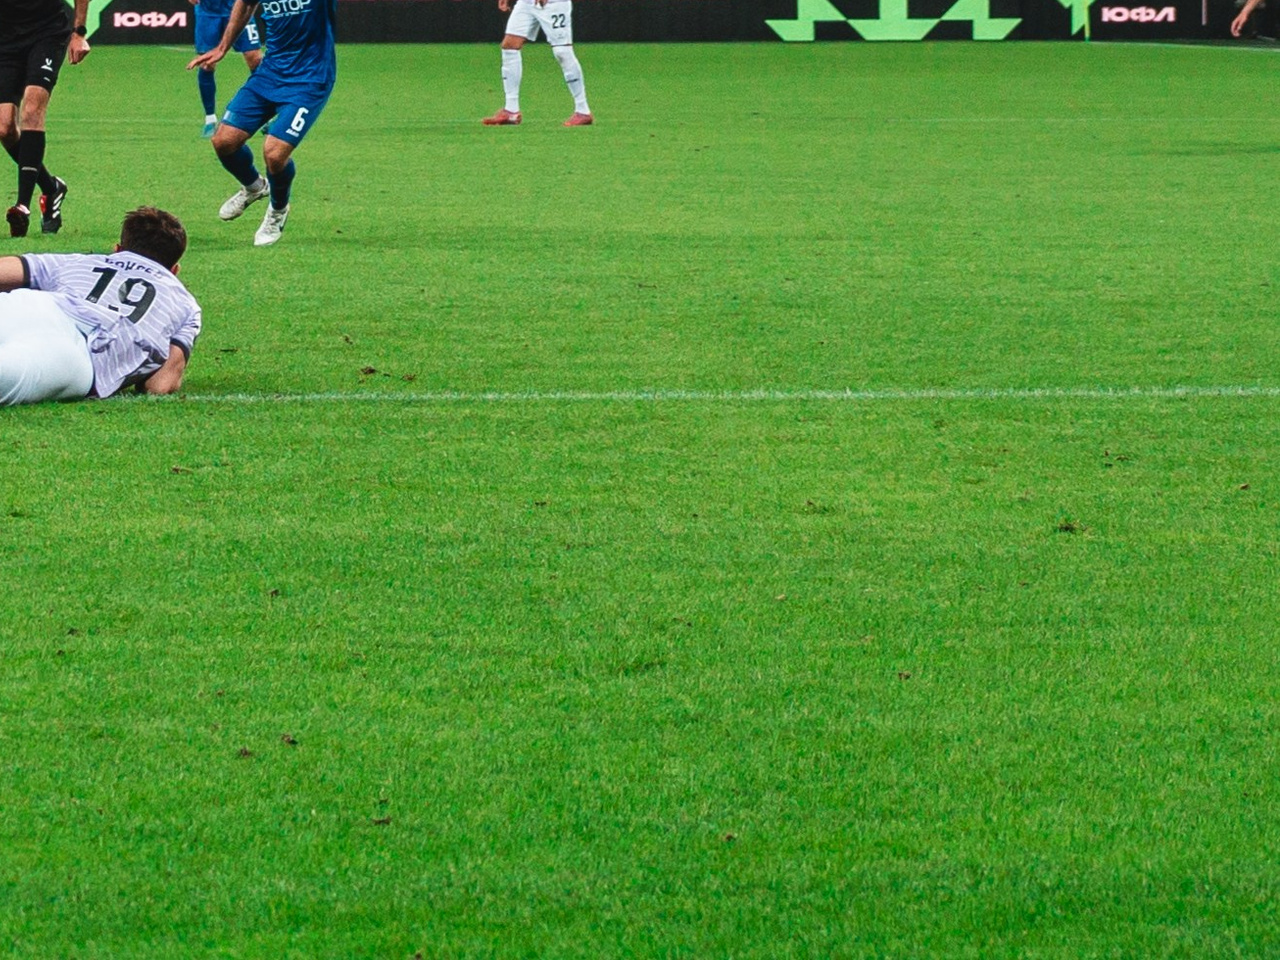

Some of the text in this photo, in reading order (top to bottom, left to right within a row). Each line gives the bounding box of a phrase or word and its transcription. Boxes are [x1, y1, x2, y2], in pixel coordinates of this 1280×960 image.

[113, 11, 187, 27] ЮФЛ
[551, 13, 566, 29] 22
[1101, 6, 1176, 22] ЮФЛ
[245, 23, 259, 41] 15
[290, 106, 309, 132] 6
[85, 266, 156, 325] 19
